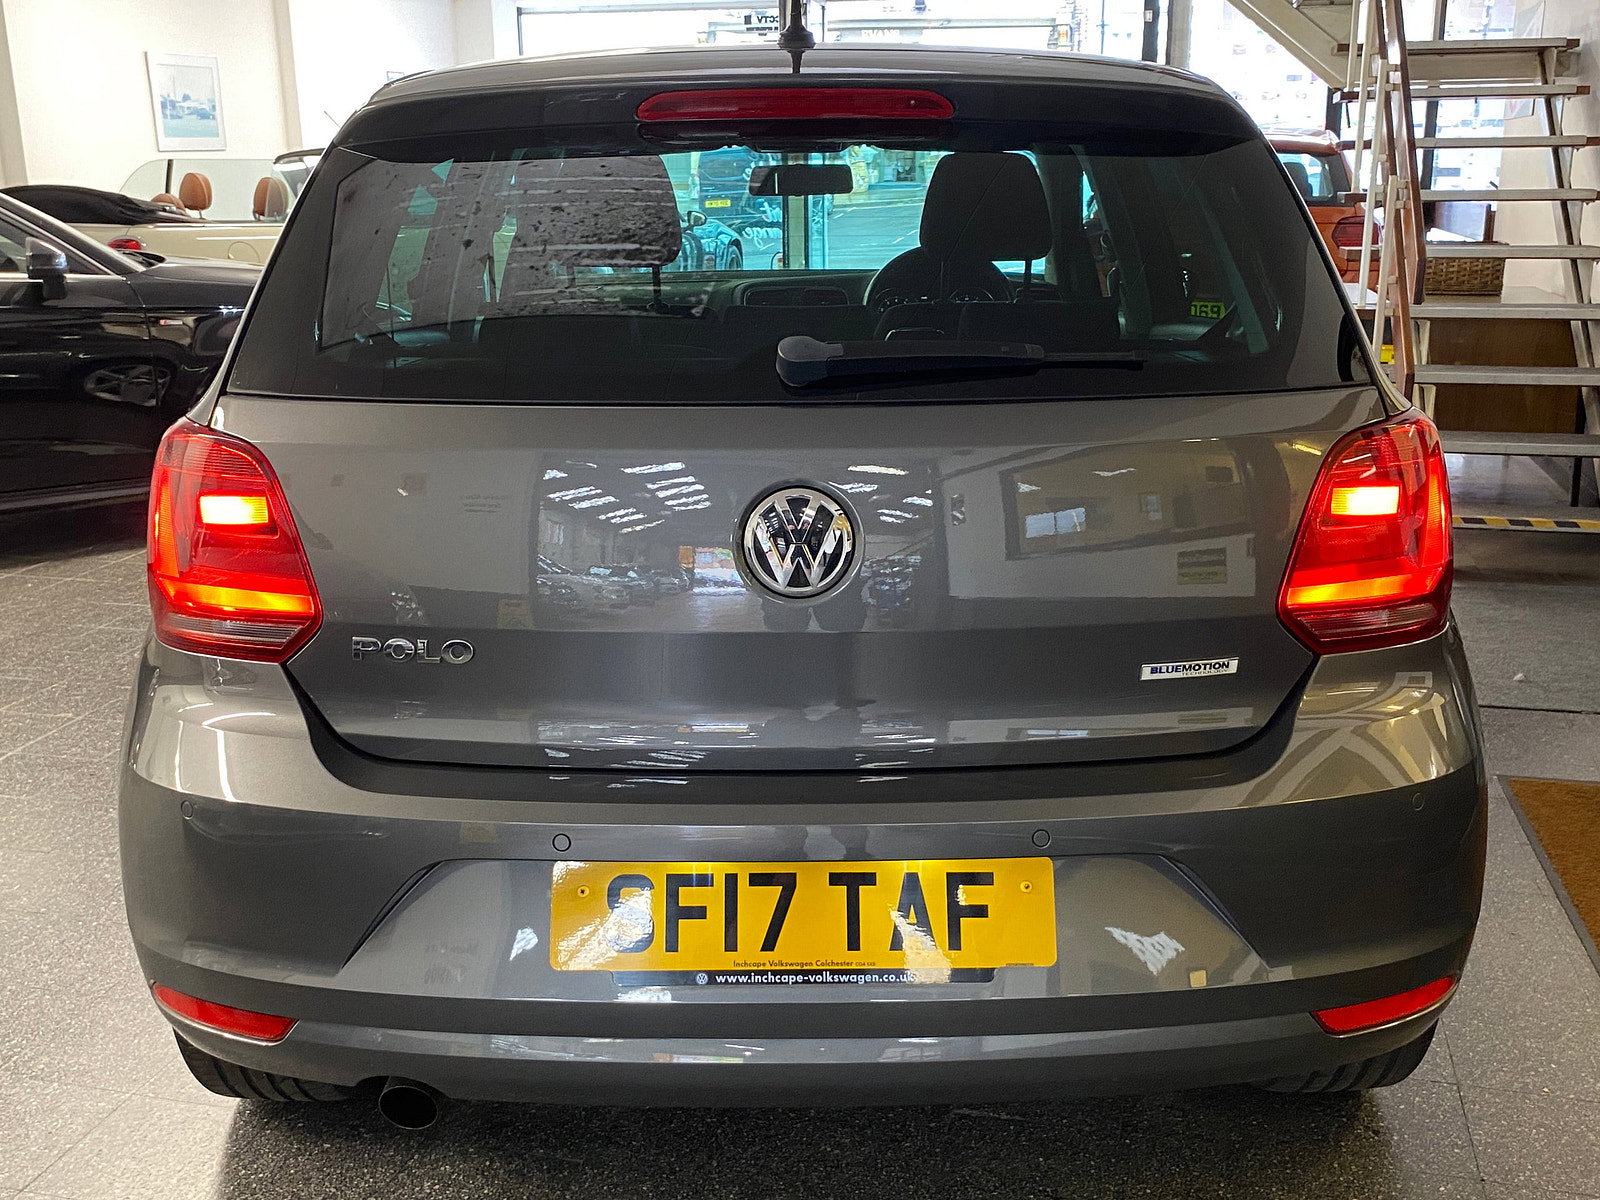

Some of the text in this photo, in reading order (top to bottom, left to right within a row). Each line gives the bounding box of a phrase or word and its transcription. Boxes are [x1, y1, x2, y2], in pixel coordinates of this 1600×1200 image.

[352, 636, 474, 665] POLO
[1150, 661, 1230, 675] BLUEMOTION
[829, 872, 994, 951] TAF
[733, 960, 766, 968] Inchcape
[768, 960, 813, 968] Volkswagen
[815, 959, 853, 967] Colchester
[715, 971, 914, 984] www.inchcape-volkswagen.co.uk
